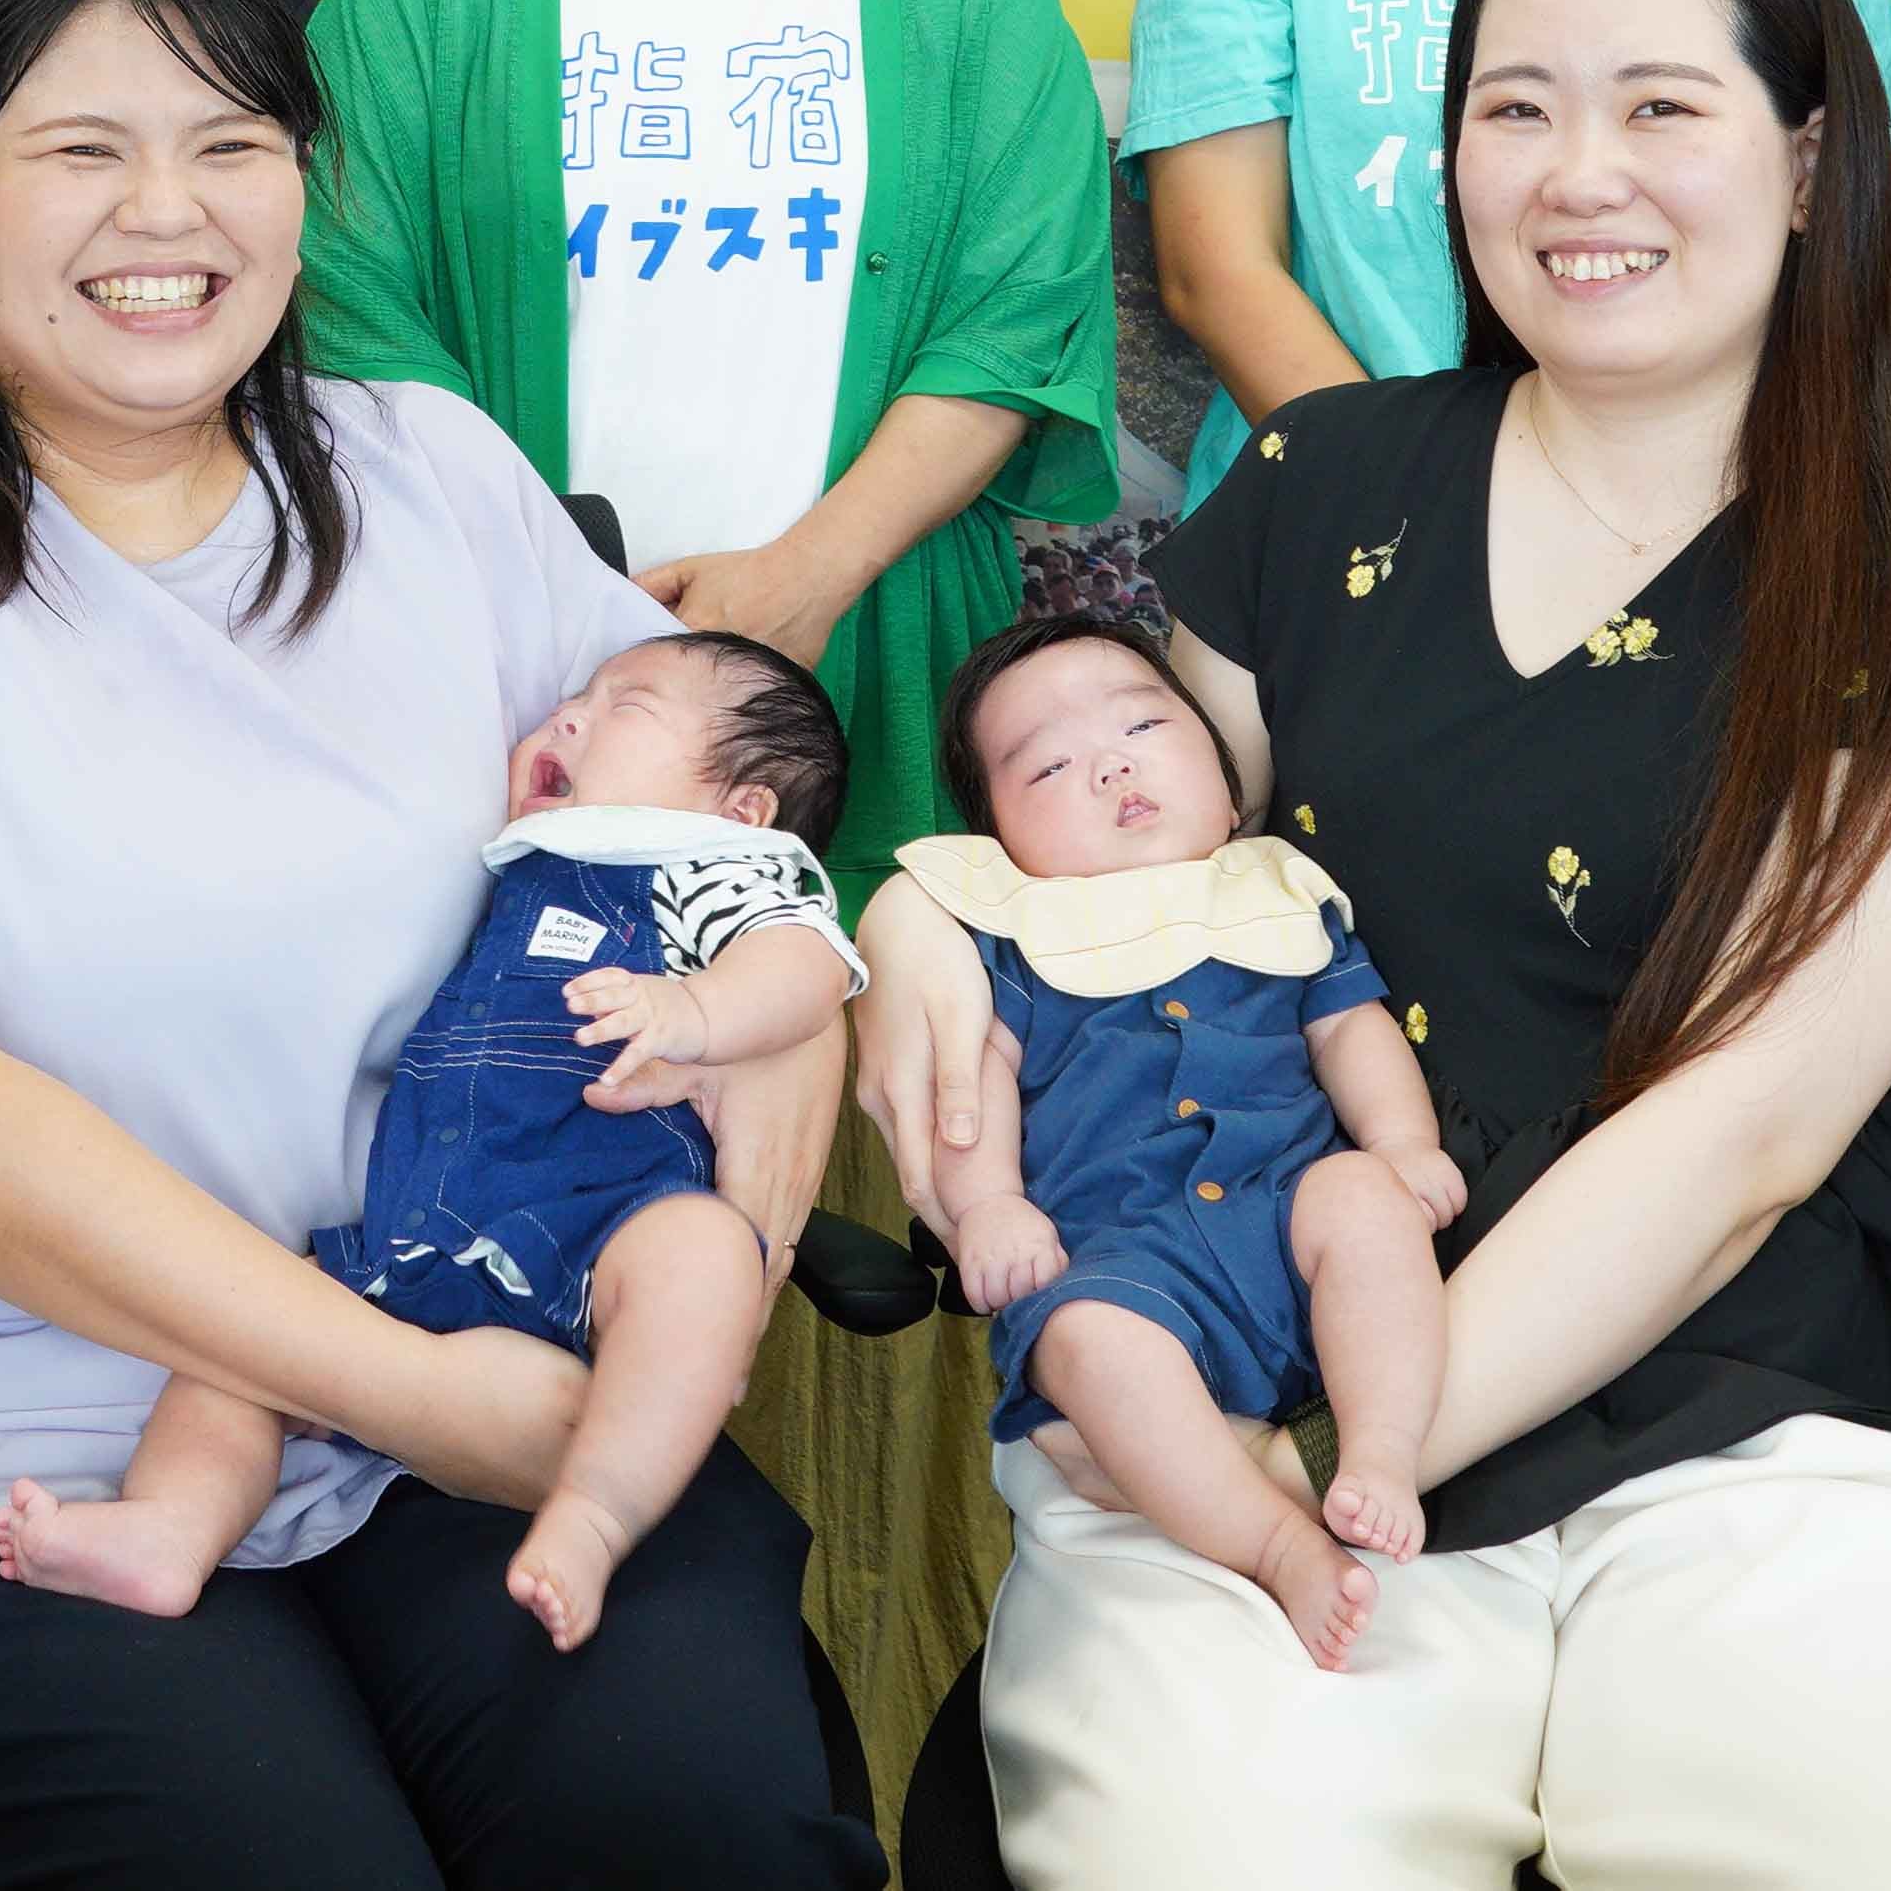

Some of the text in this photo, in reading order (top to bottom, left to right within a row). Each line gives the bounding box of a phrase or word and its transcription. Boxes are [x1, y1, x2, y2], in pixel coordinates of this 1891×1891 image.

[562, 26, 851, 170] 指宿
[567, 187, 842, 283] イブスキ
